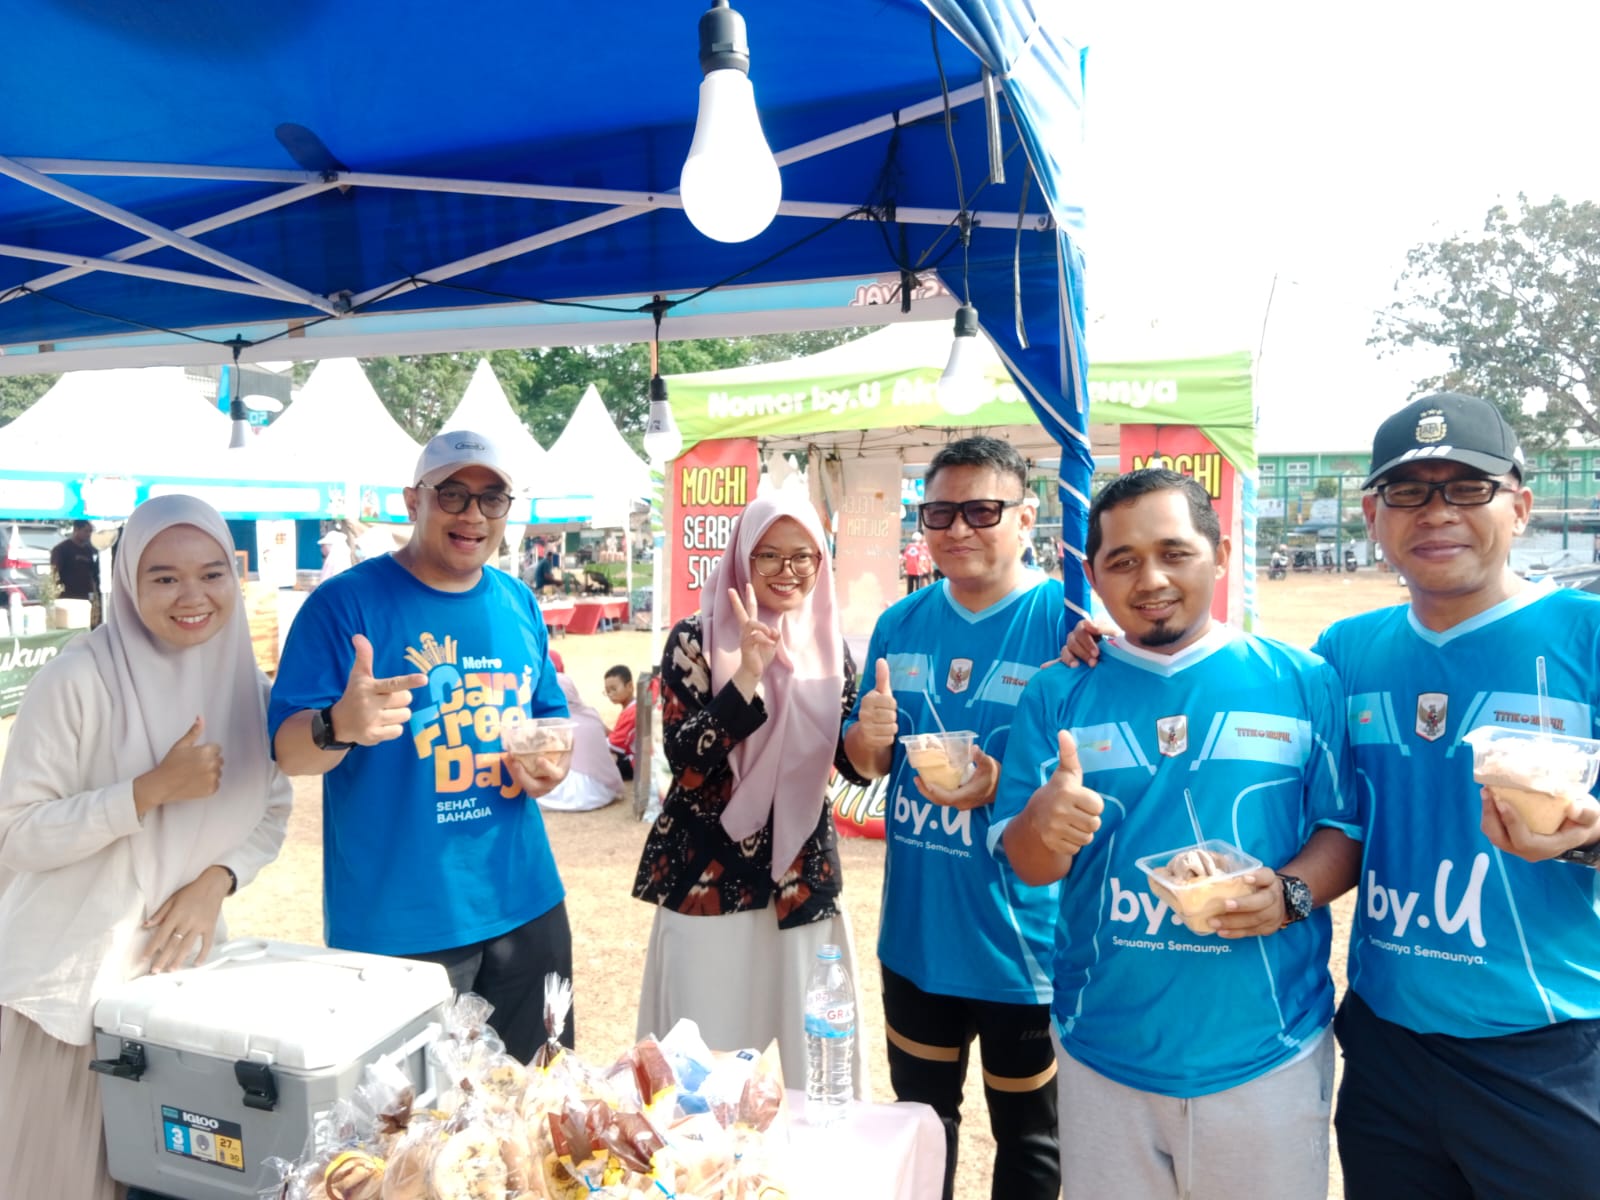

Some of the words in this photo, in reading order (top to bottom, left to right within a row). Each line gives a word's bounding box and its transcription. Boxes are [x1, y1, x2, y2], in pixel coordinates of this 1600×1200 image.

[707, 392, 805, 418] Nomor
[810, 381, 882, 414] by.U
[681, 465, 748, 507] MOCHI
[462, 656, 503, 670] Metro
[409, 703, 528, 760] Free
[434, 744, 524, 799] Day
[436, 797, 477, 812] SEHAT
[436, 806, 493, 824] BAHAGIA
[894, 784, 973, 847] by.U
[1366, 852, 1490, 948] by.U
[1167, 940, 1232, 955] Semaunya.
[1413, 944, 1488, 966] Semaunya.
[182, 1111, 219, 1129] IGLOO
[171, 1127, 184, 1145] 3
